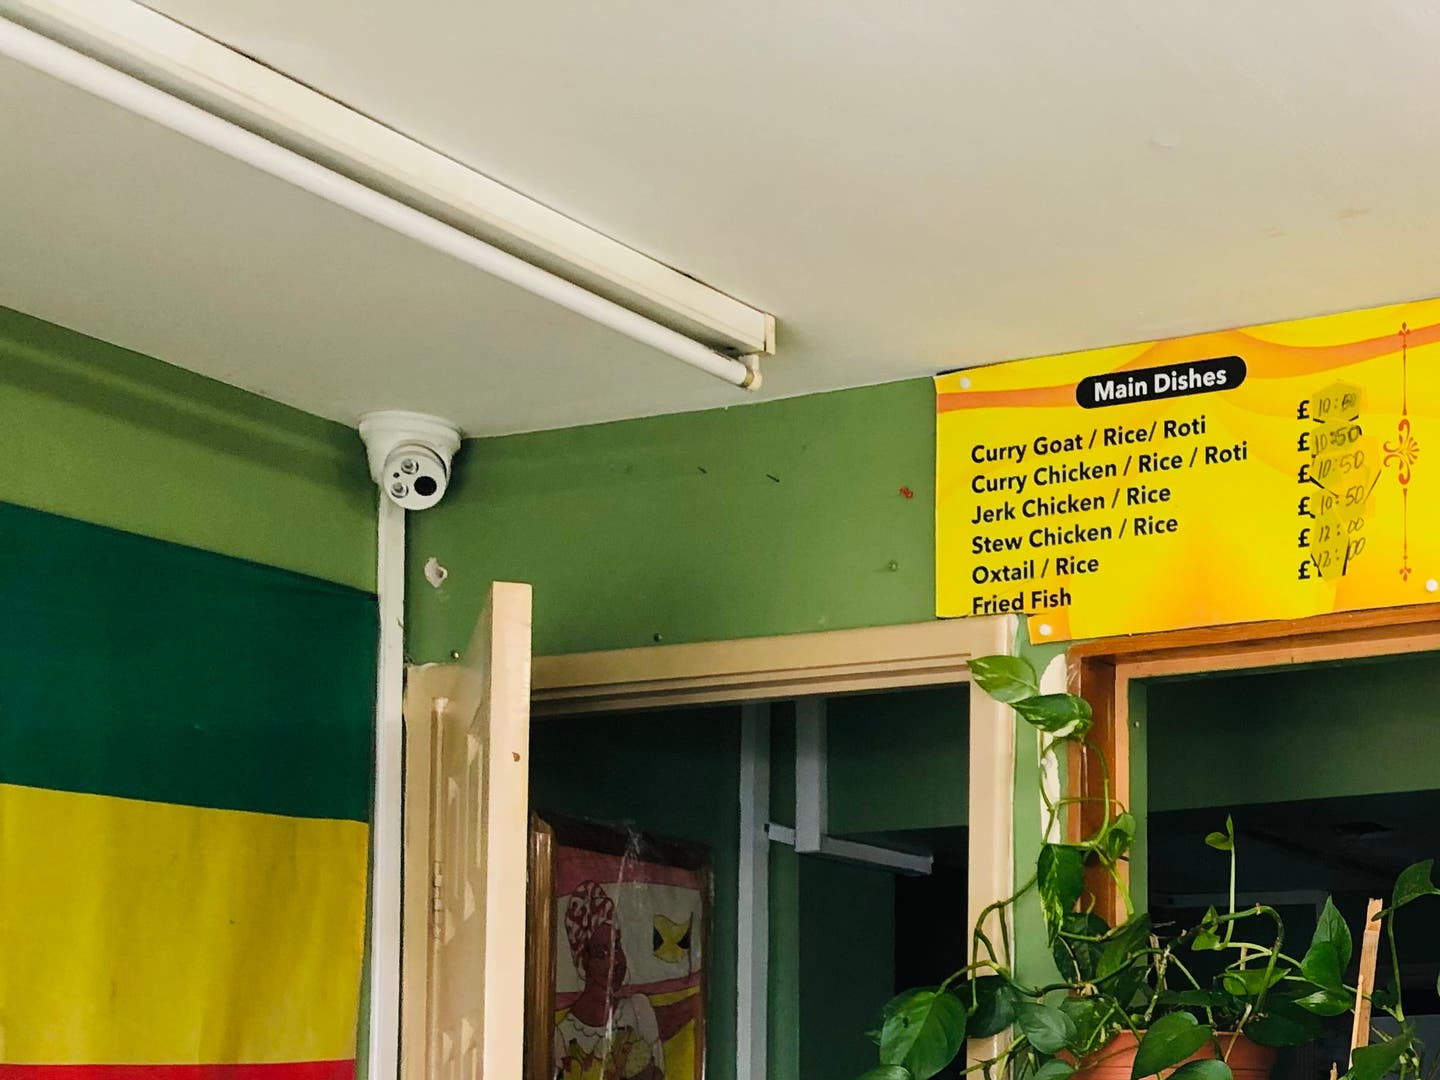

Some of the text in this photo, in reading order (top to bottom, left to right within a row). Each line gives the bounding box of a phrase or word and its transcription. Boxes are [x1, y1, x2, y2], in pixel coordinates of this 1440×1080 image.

[1094, 368, 1227, 401] Main Dishes
[971, 444, 1027, 463] Curry
[1033, 435, 1082, 455] Goat
[1104, 422, 1156, 446] Rice/
[1164, 415, 1205, 438] Roti
[972, 475, 1027, 494] Curry
[1034, 462, 1116, 485] Chicken
[1139, 452, 1182, 473] Rice
[1205, 441, 1247, 464] Roti
[1318, 451, 1365, 480] 10:50
[972, 501, 1015, 524] Jerk
[1022, 494, 1104, 518] Chicken
[1127, 485, 1170, 505] Rice
[972, 536, 1022, 554] Stew
[1029, 524, 1111, 547] Chicken
[1134, 516, 1178, 536] Rice
[972, 560, 1034, 584] Oxtail
[1056, 556, 1099, 575] Rice
[972, 588, 1071, 615] Fried Fish
